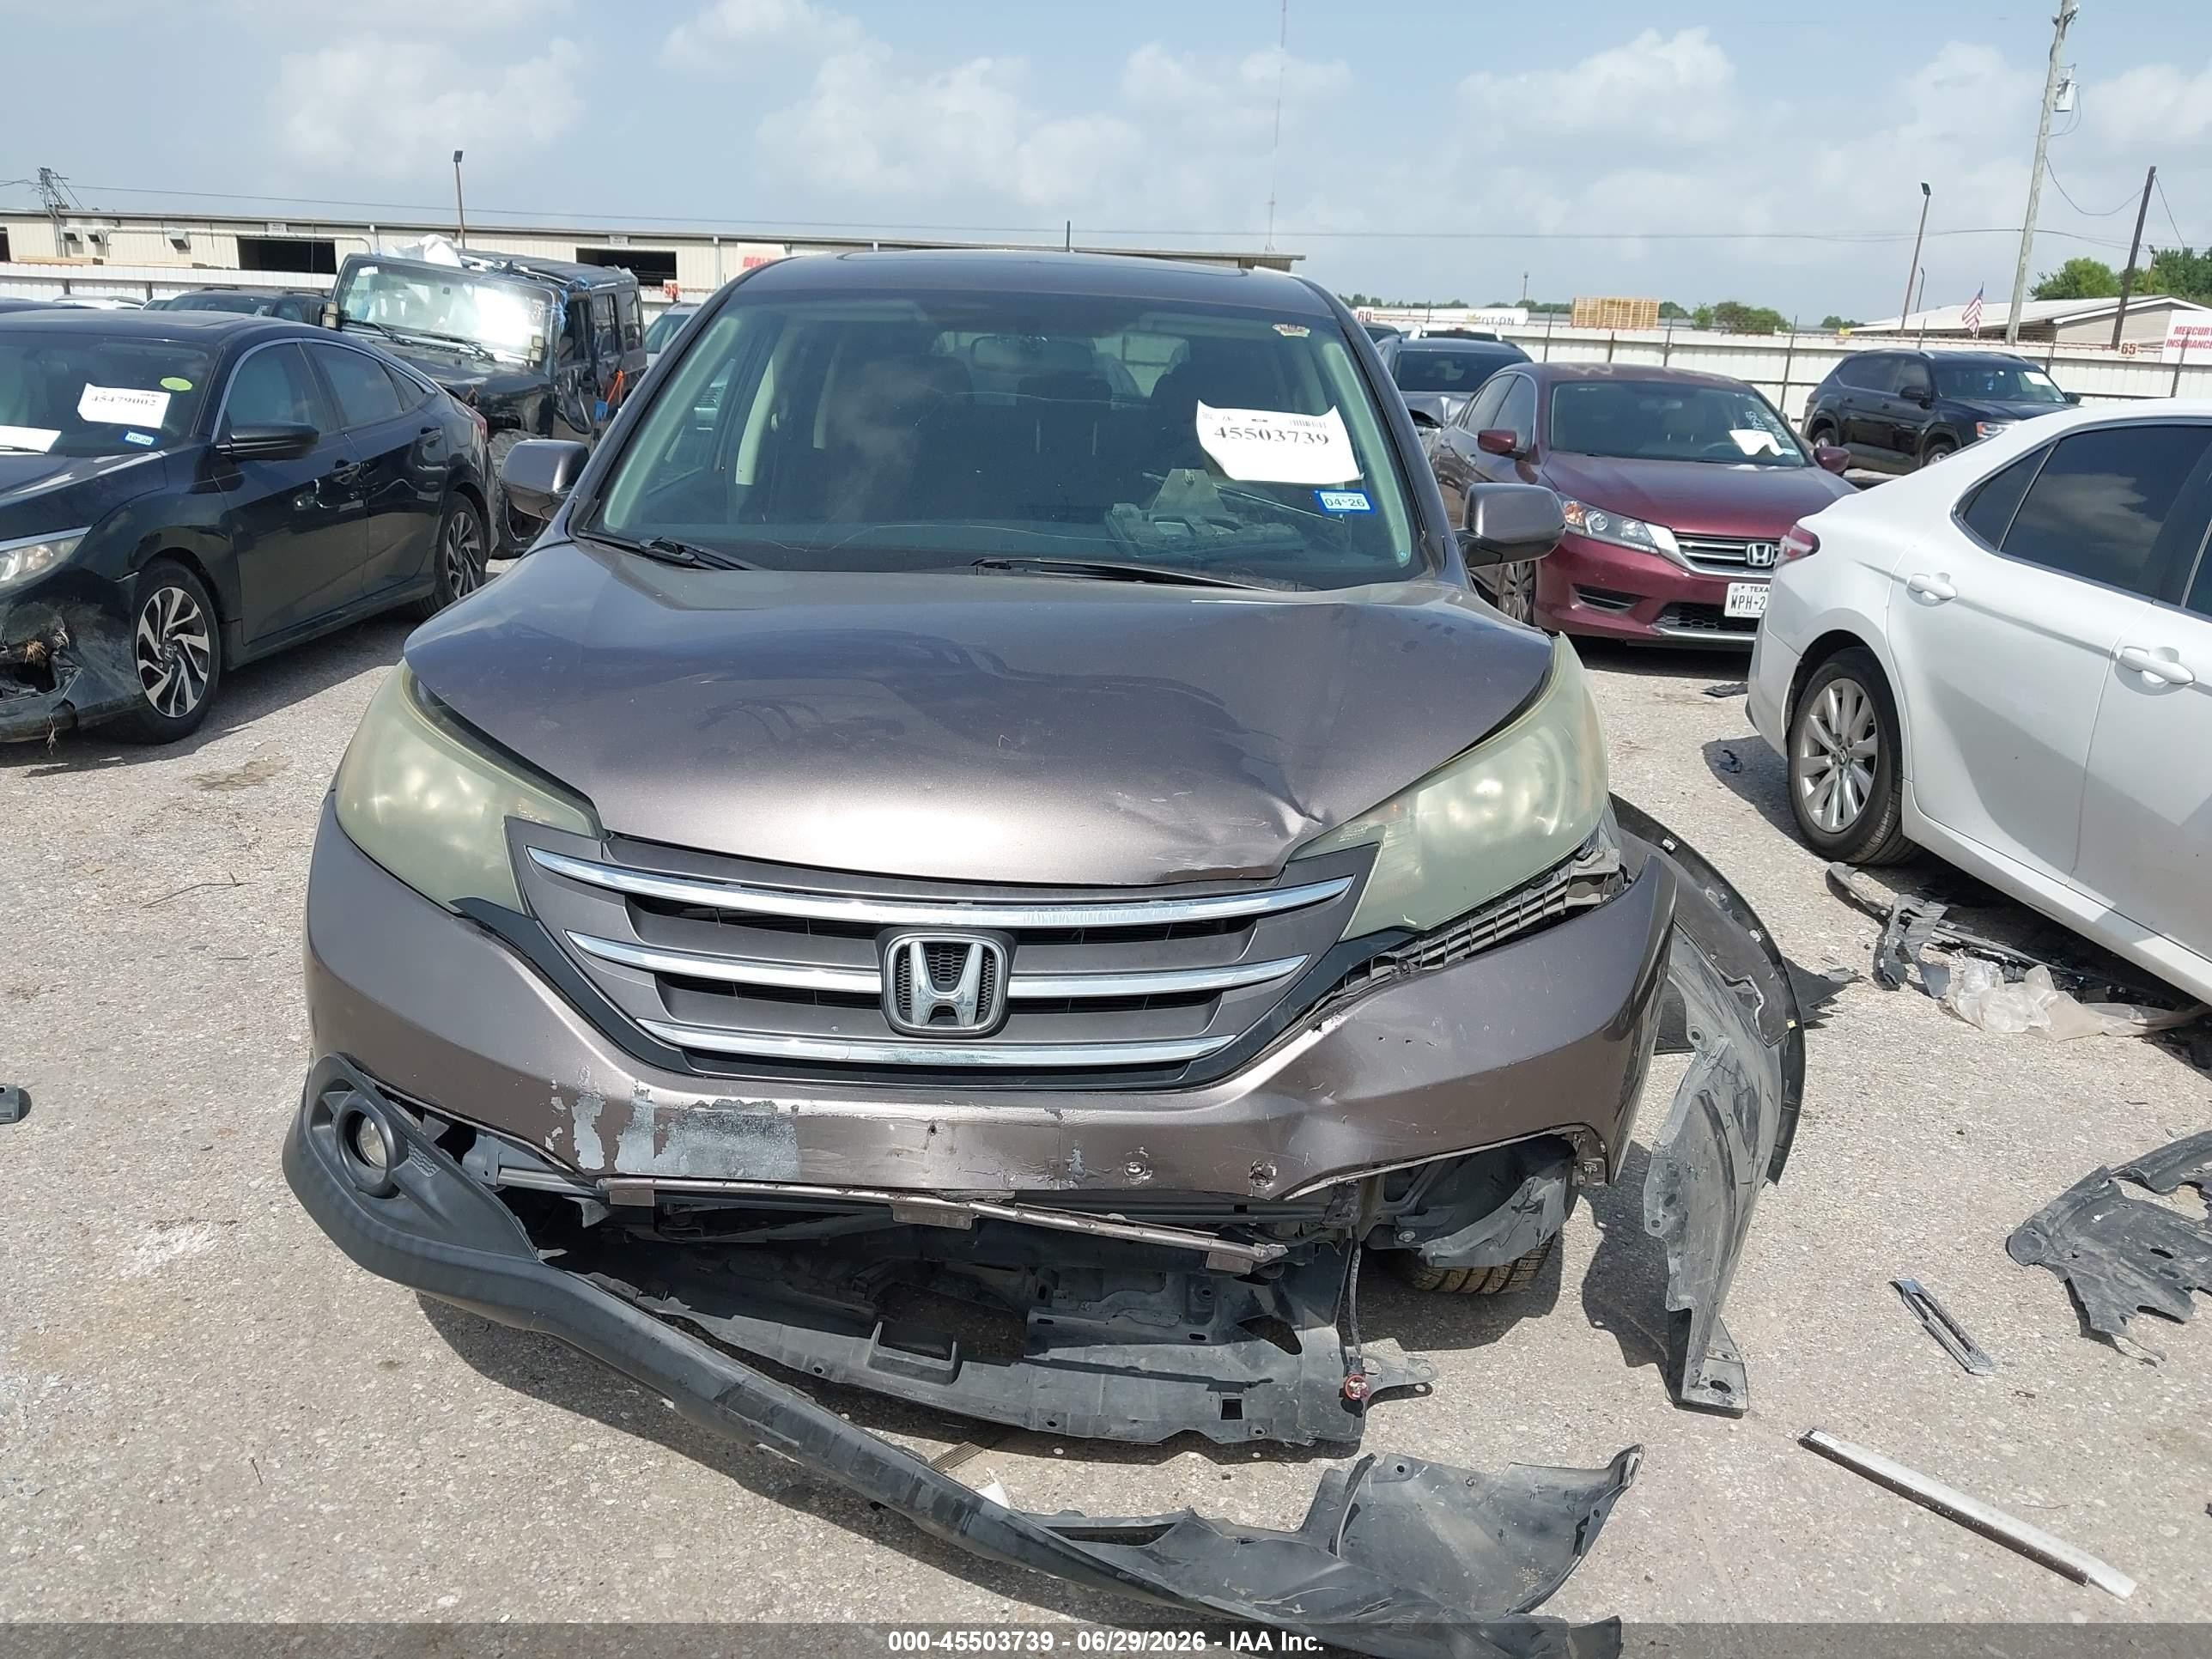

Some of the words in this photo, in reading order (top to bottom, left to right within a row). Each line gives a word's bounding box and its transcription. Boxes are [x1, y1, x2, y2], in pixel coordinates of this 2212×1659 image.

[2121, 343, 2136, 355] 65
[1213, 426, 1329, 446] 45503739
[1731, 595, 1766, 611] WPH-2
